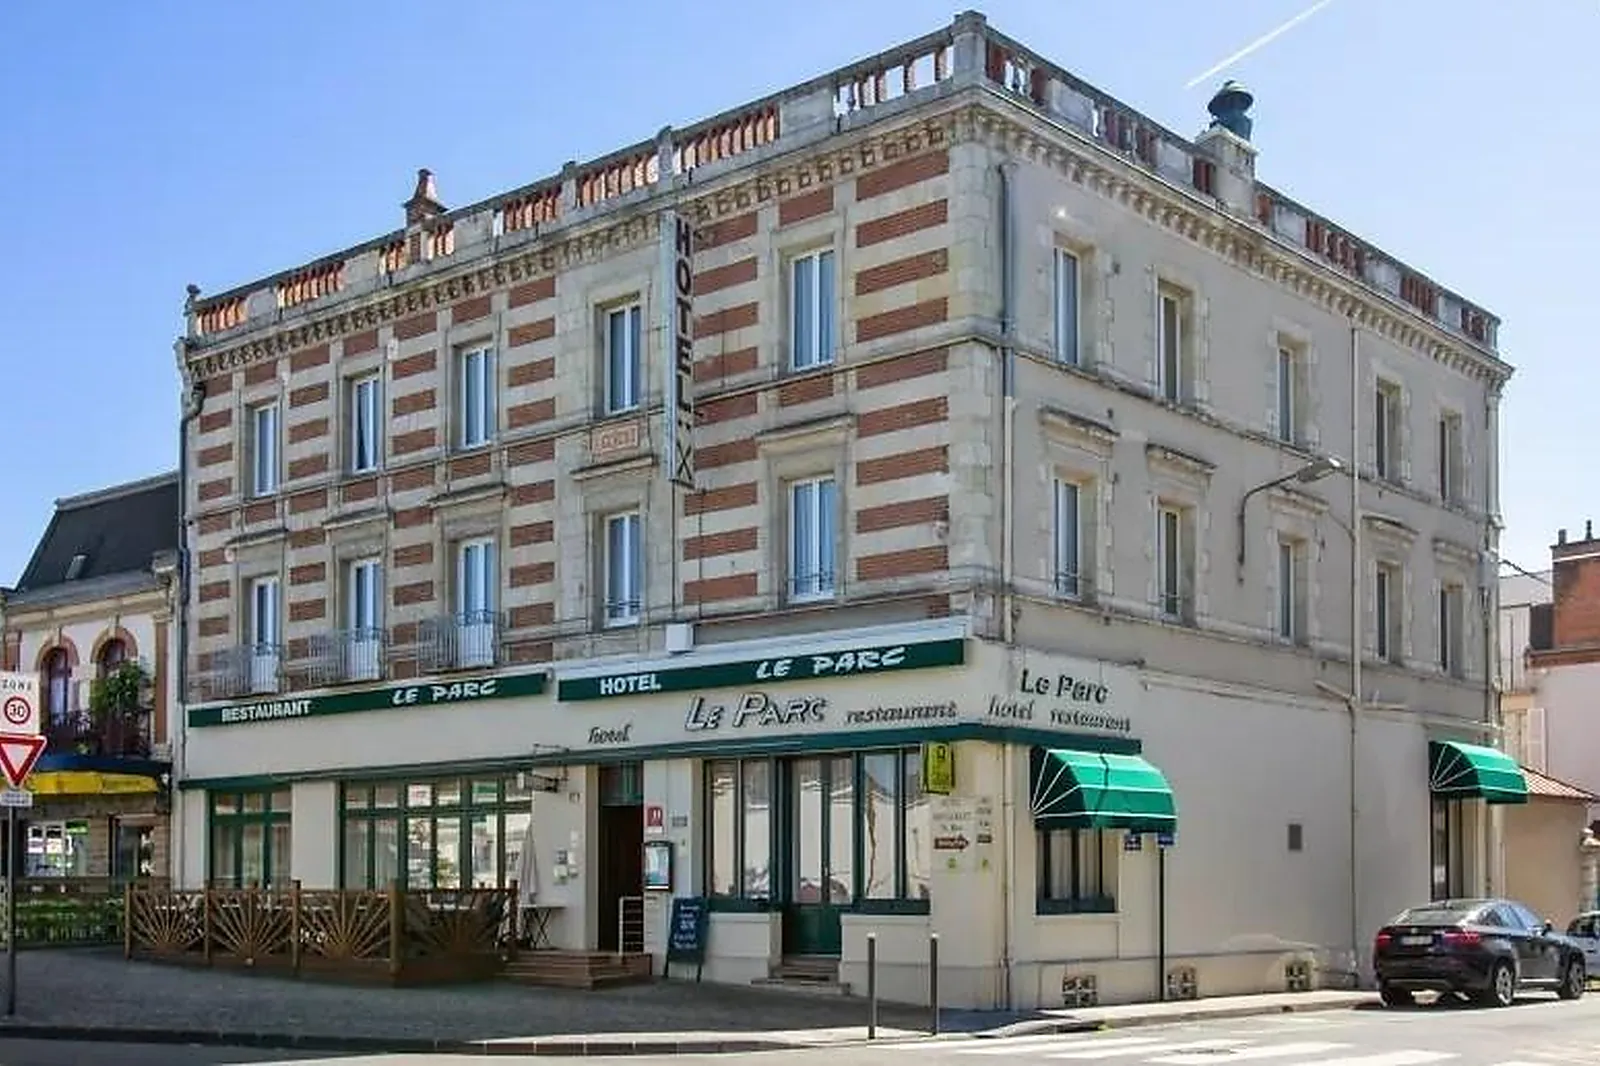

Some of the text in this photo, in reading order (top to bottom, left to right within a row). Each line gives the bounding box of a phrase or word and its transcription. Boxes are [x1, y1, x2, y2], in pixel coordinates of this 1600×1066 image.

[676, 217, 692, 414] HOTEL
[755, 646, 905, 679] LE PARC
[3, 679, 32, 690] ZONE
[392, 679, 497, 705] LE PARC
[600, 673, 662, 695] HOTEL
[1020, 667, 1109, 704] Le Parc
[9, 704, 25, 717] 30
[221, 700, 311, 723] RESTAURANT
[844, 701, 957, 724] restaurant
[987, 694, 1035, 721] hotel
